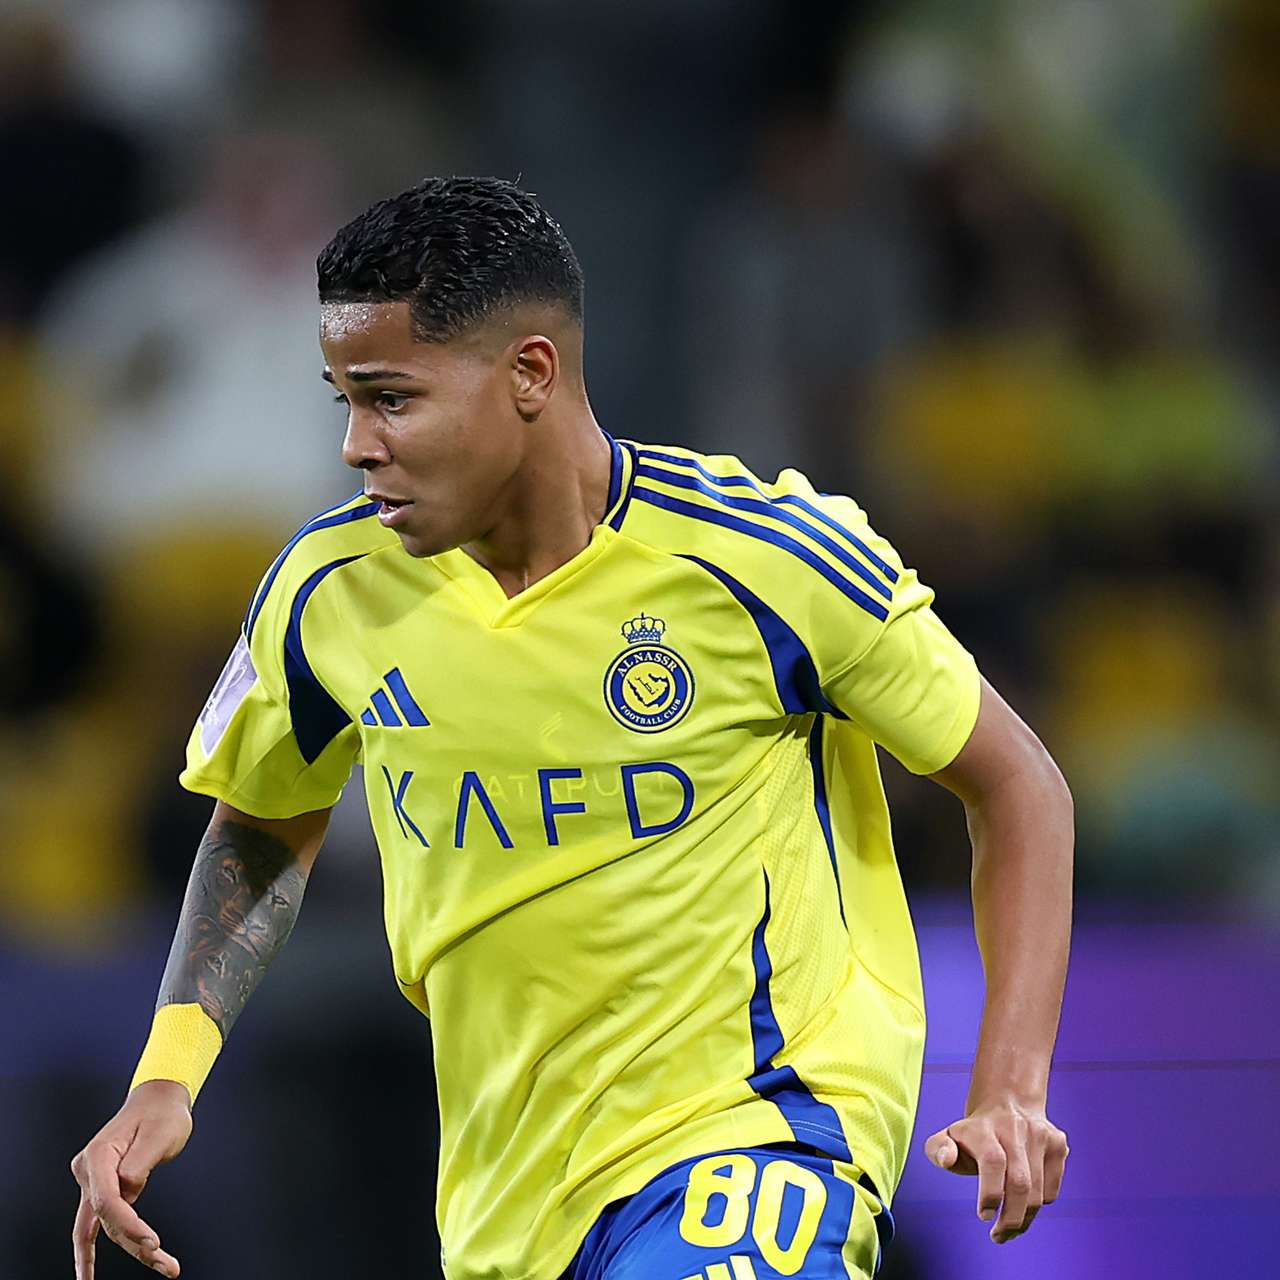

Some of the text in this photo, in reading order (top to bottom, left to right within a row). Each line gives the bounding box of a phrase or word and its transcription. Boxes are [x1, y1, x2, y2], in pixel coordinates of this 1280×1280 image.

[616, 651, 678, 678] AL NASSR
[620, 698, 681, 725] FOOTBALL CLUB
[381, 761, 696, 849] KAFD
[679, 1153, 828, 1277] 80
